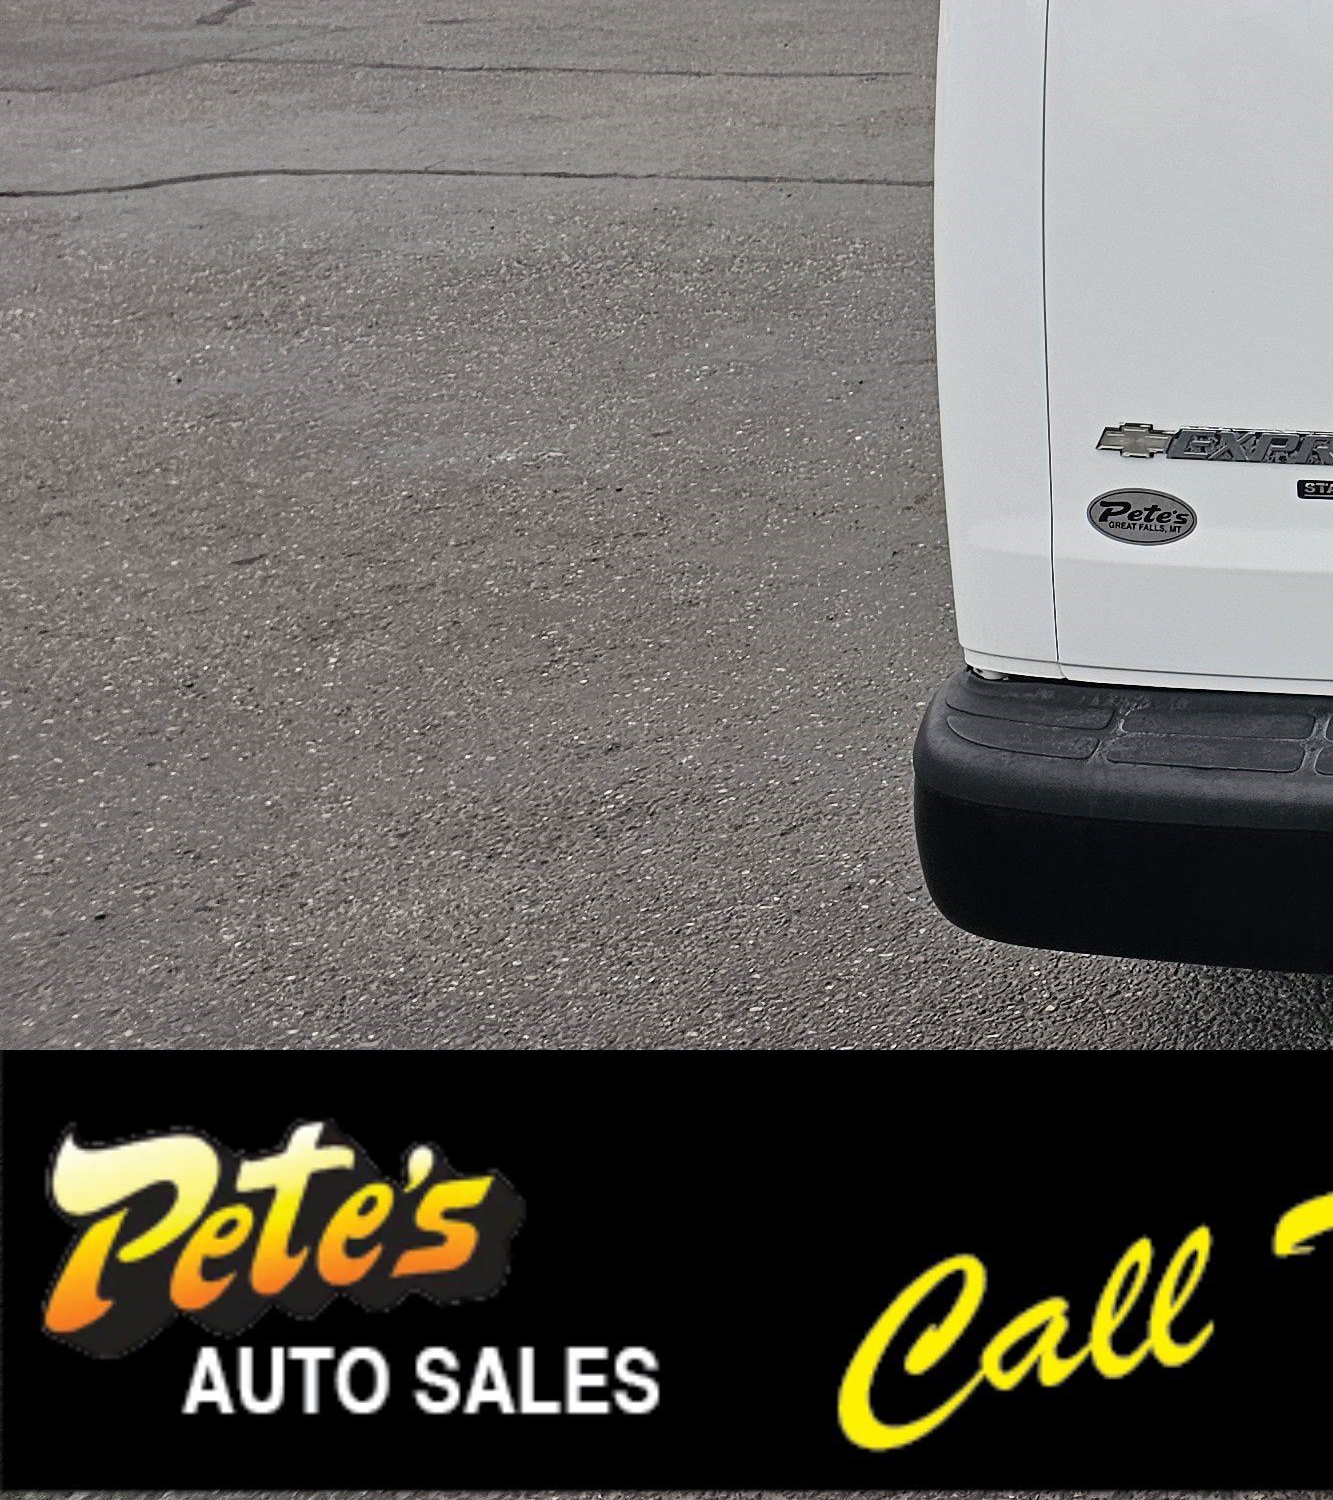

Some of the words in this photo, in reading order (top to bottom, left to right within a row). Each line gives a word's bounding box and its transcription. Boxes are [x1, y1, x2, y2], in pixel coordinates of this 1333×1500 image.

[1098, 500, 1190, 525] Pete's
[1108, 521, 1138, 530] GREAT
[1138, 523, 1168, 534] FALLS,
